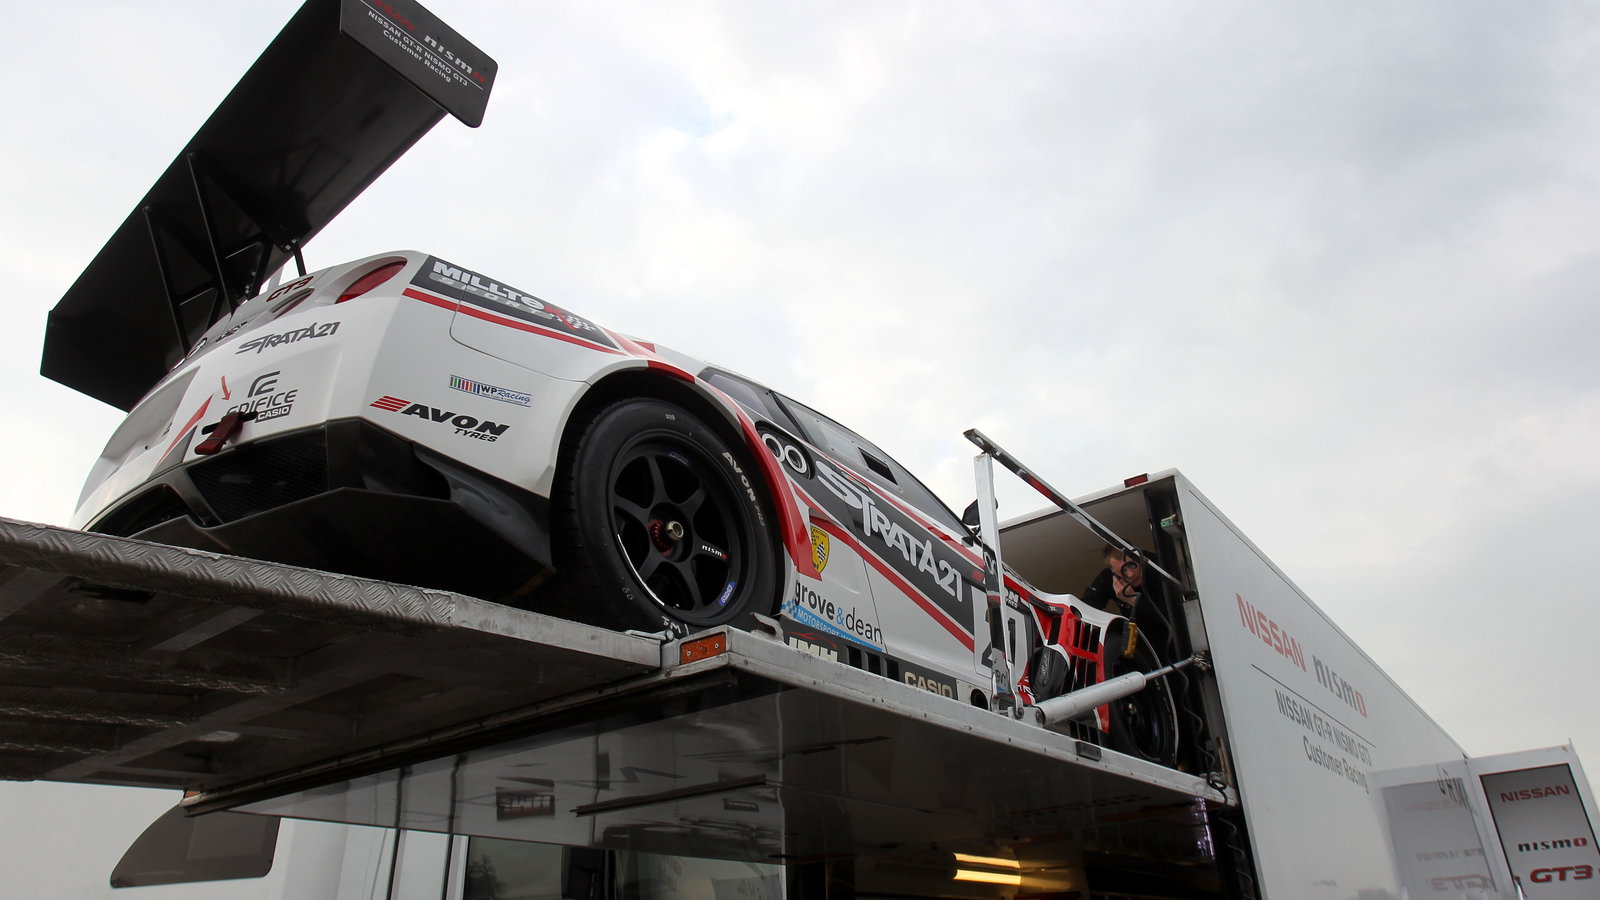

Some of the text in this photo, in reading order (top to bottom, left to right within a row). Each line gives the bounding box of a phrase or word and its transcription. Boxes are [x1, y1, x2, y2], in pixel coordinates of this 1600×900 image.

[368, 10, 468, 86] NISSAN GT-R NISMO GT3
[383, 30, 451, 83] Customer Racing
[266, 276, 314, 303] GT3
[235, 322, 341, 355] STRATA21
[257, 405, 290, 420] CASIO
[401, 403, 511, 436] AVON
[454, 428, 499, 442] TYRES
[721, 452, 756, 502] AVON
[816, 461, 962, 602] STRATA21
[701, 544, 729, 560] nismo
[1235, 592, 1368, 719] NISSAN nismo
[904, 671, 953, 699] CASIO
[1274, 688, 1314, 732] NISSAN
[1313, 713, 1333, 740] GT-R
[1333, 726, 1358, 757] NISMO
[1303, 735, 1370, 795] Customer Racing
[1499, 784, 1570, 803] NISSAN
[1518, 837, 1588, 852] nismo
[1529, 864, 1594, 884] GT3
